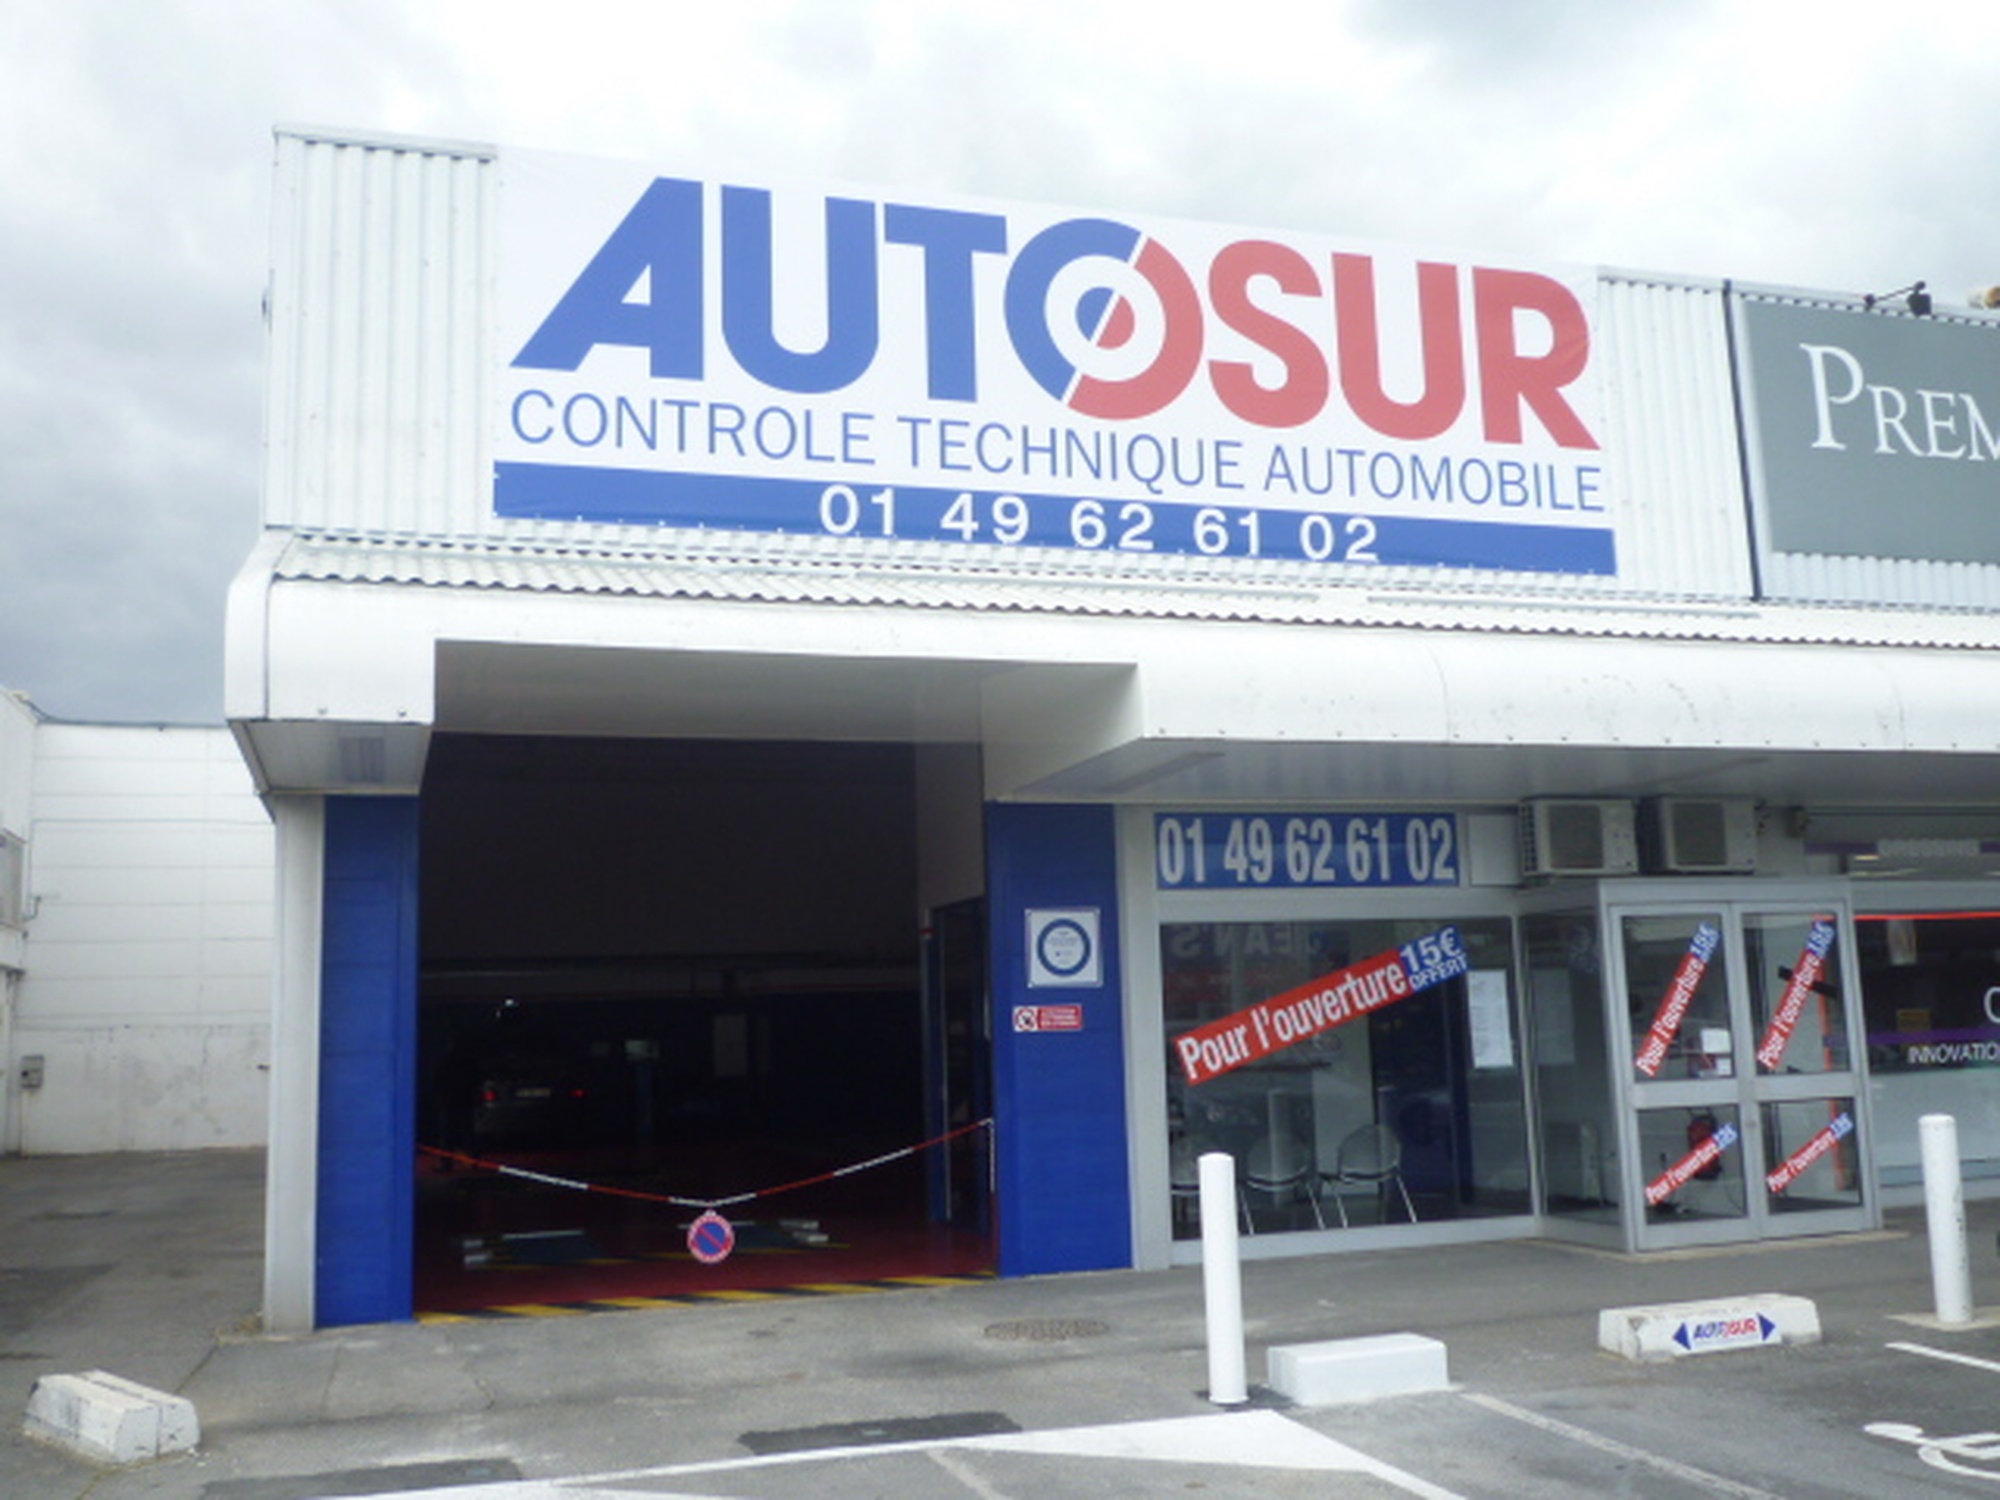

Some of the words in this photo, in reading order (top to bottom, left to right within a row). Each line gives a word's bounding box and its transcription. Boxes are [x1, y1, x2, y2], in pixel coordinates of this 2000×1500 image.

[508, 175, 1601, 451] AUTOSUR
[511, 388, 876, 466] CONTROLE
[896, 415, 1245, 494] TECHNIQUE
[1263, 443, 1605, 513] AUTOMOBILE
[819, 484, 896, 537] 01
[940, 492, 1030, 544] 49
[1069, 499, 1155, 552] 62
[1192, 507, 1261, 556] 61
[1299, 513, 1380, 563] 02
[1158, 817, 1206, 884] 01
[1223, 818, 1273, 883] 49
[1285, 818, 1336, 882] 62
[1346, 818, 1391, 882] 61
[1405, 818, 1456, 881] 02
[1177, 1023, 1250, 1081] Pour
[1250, 960, 1406, 1050] l'ouverture
[1400, 926, 1461, 973] 15€
[1408, 952, 1468, 992] OFFERT
